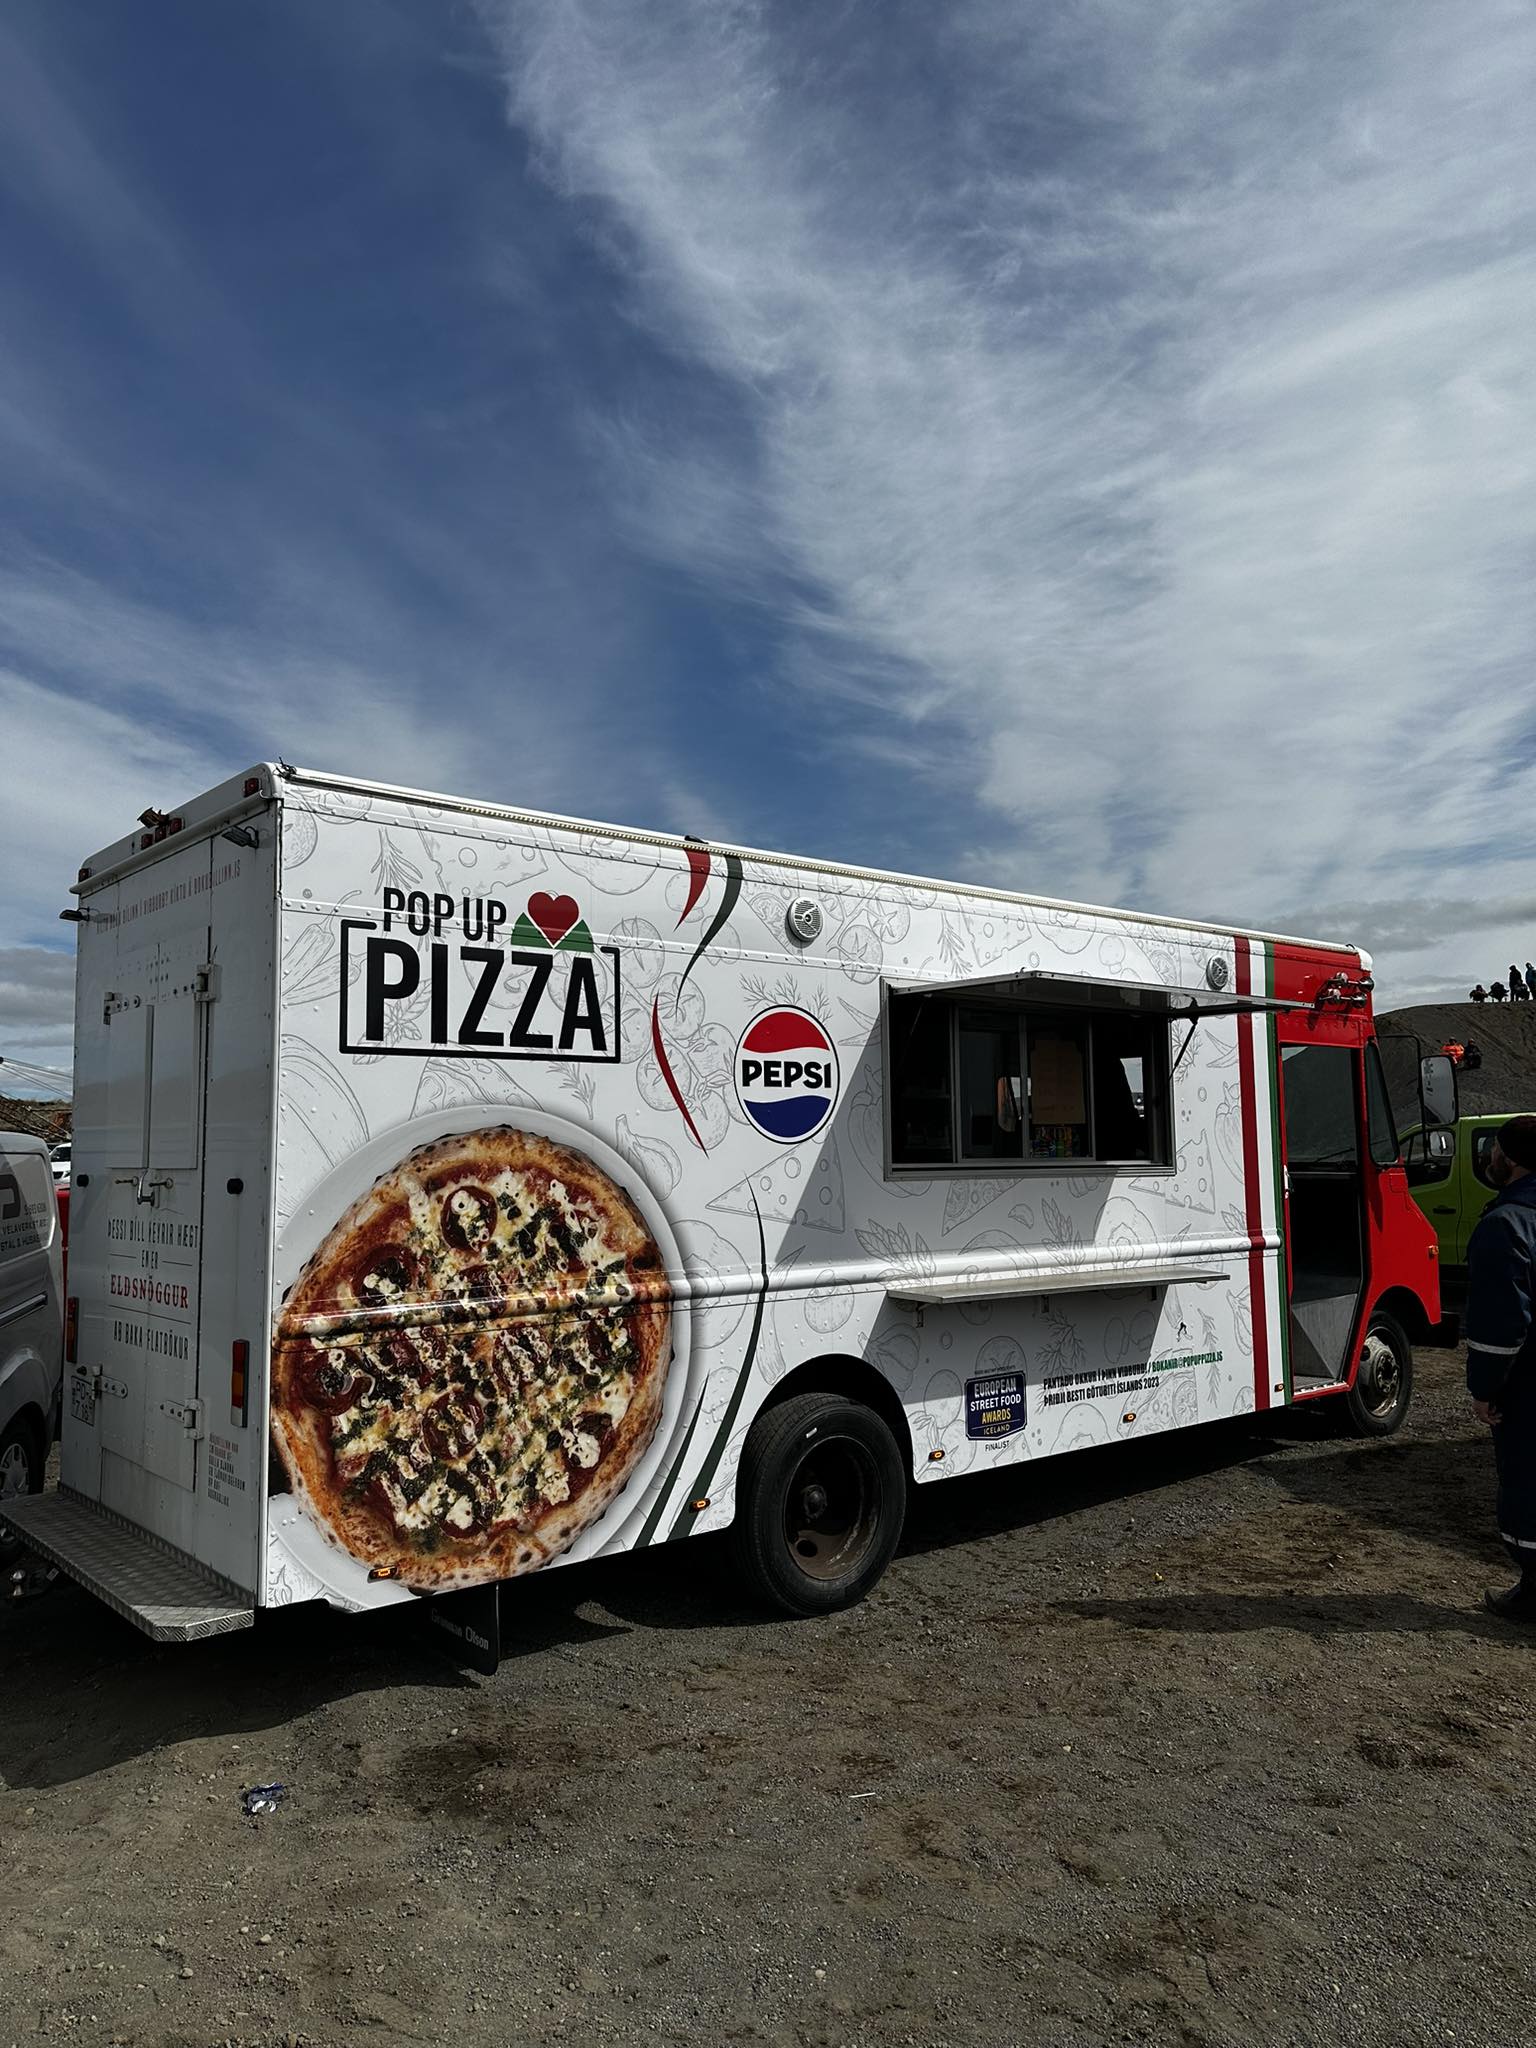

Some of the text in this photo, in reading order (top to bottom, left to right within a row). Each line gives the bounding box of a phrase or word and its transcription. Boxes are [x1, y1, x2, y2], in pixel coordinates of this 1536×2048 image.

[382, 886, 507, 942] POP UP
[365, 937, 608, 1052] PIZZA
[741, 1059, 832, 1090] PEPSI
[129, 1215, 145, 1242] BÍLL
[177, 1224, 199, 1248] HÆGT
[141, 1249, 158, 1270] EN ER
[110, 1274, 189, 1310] ELDSNÖGGUR
[125, 1323, 143, 1348] BAKA
[146, 1329, 189, 1360] FLATBÖKUR
[974, 1378, 1017, 1398] EUROPEAN
[1066, 1388, 1086, 1402] BESTI
[1086, 1383, 1117, 1399] GÖTUBITI
[1116, 1379, 1144, 1395] ÍSLANDS
[1143, 1376, 1160, 1389] 2023
[1074, 1371, 1098, 1386] OKKUR
[970, 1394, 1022, 1412] STREET FOOD
[981, 1407, 1012, 1424] AWARDS
[983, 1424, 1011, 1435] ICELAND
[984, 1440, 1010, 1452] FINALIST
[465, 1625, 489, 1650] Olson
